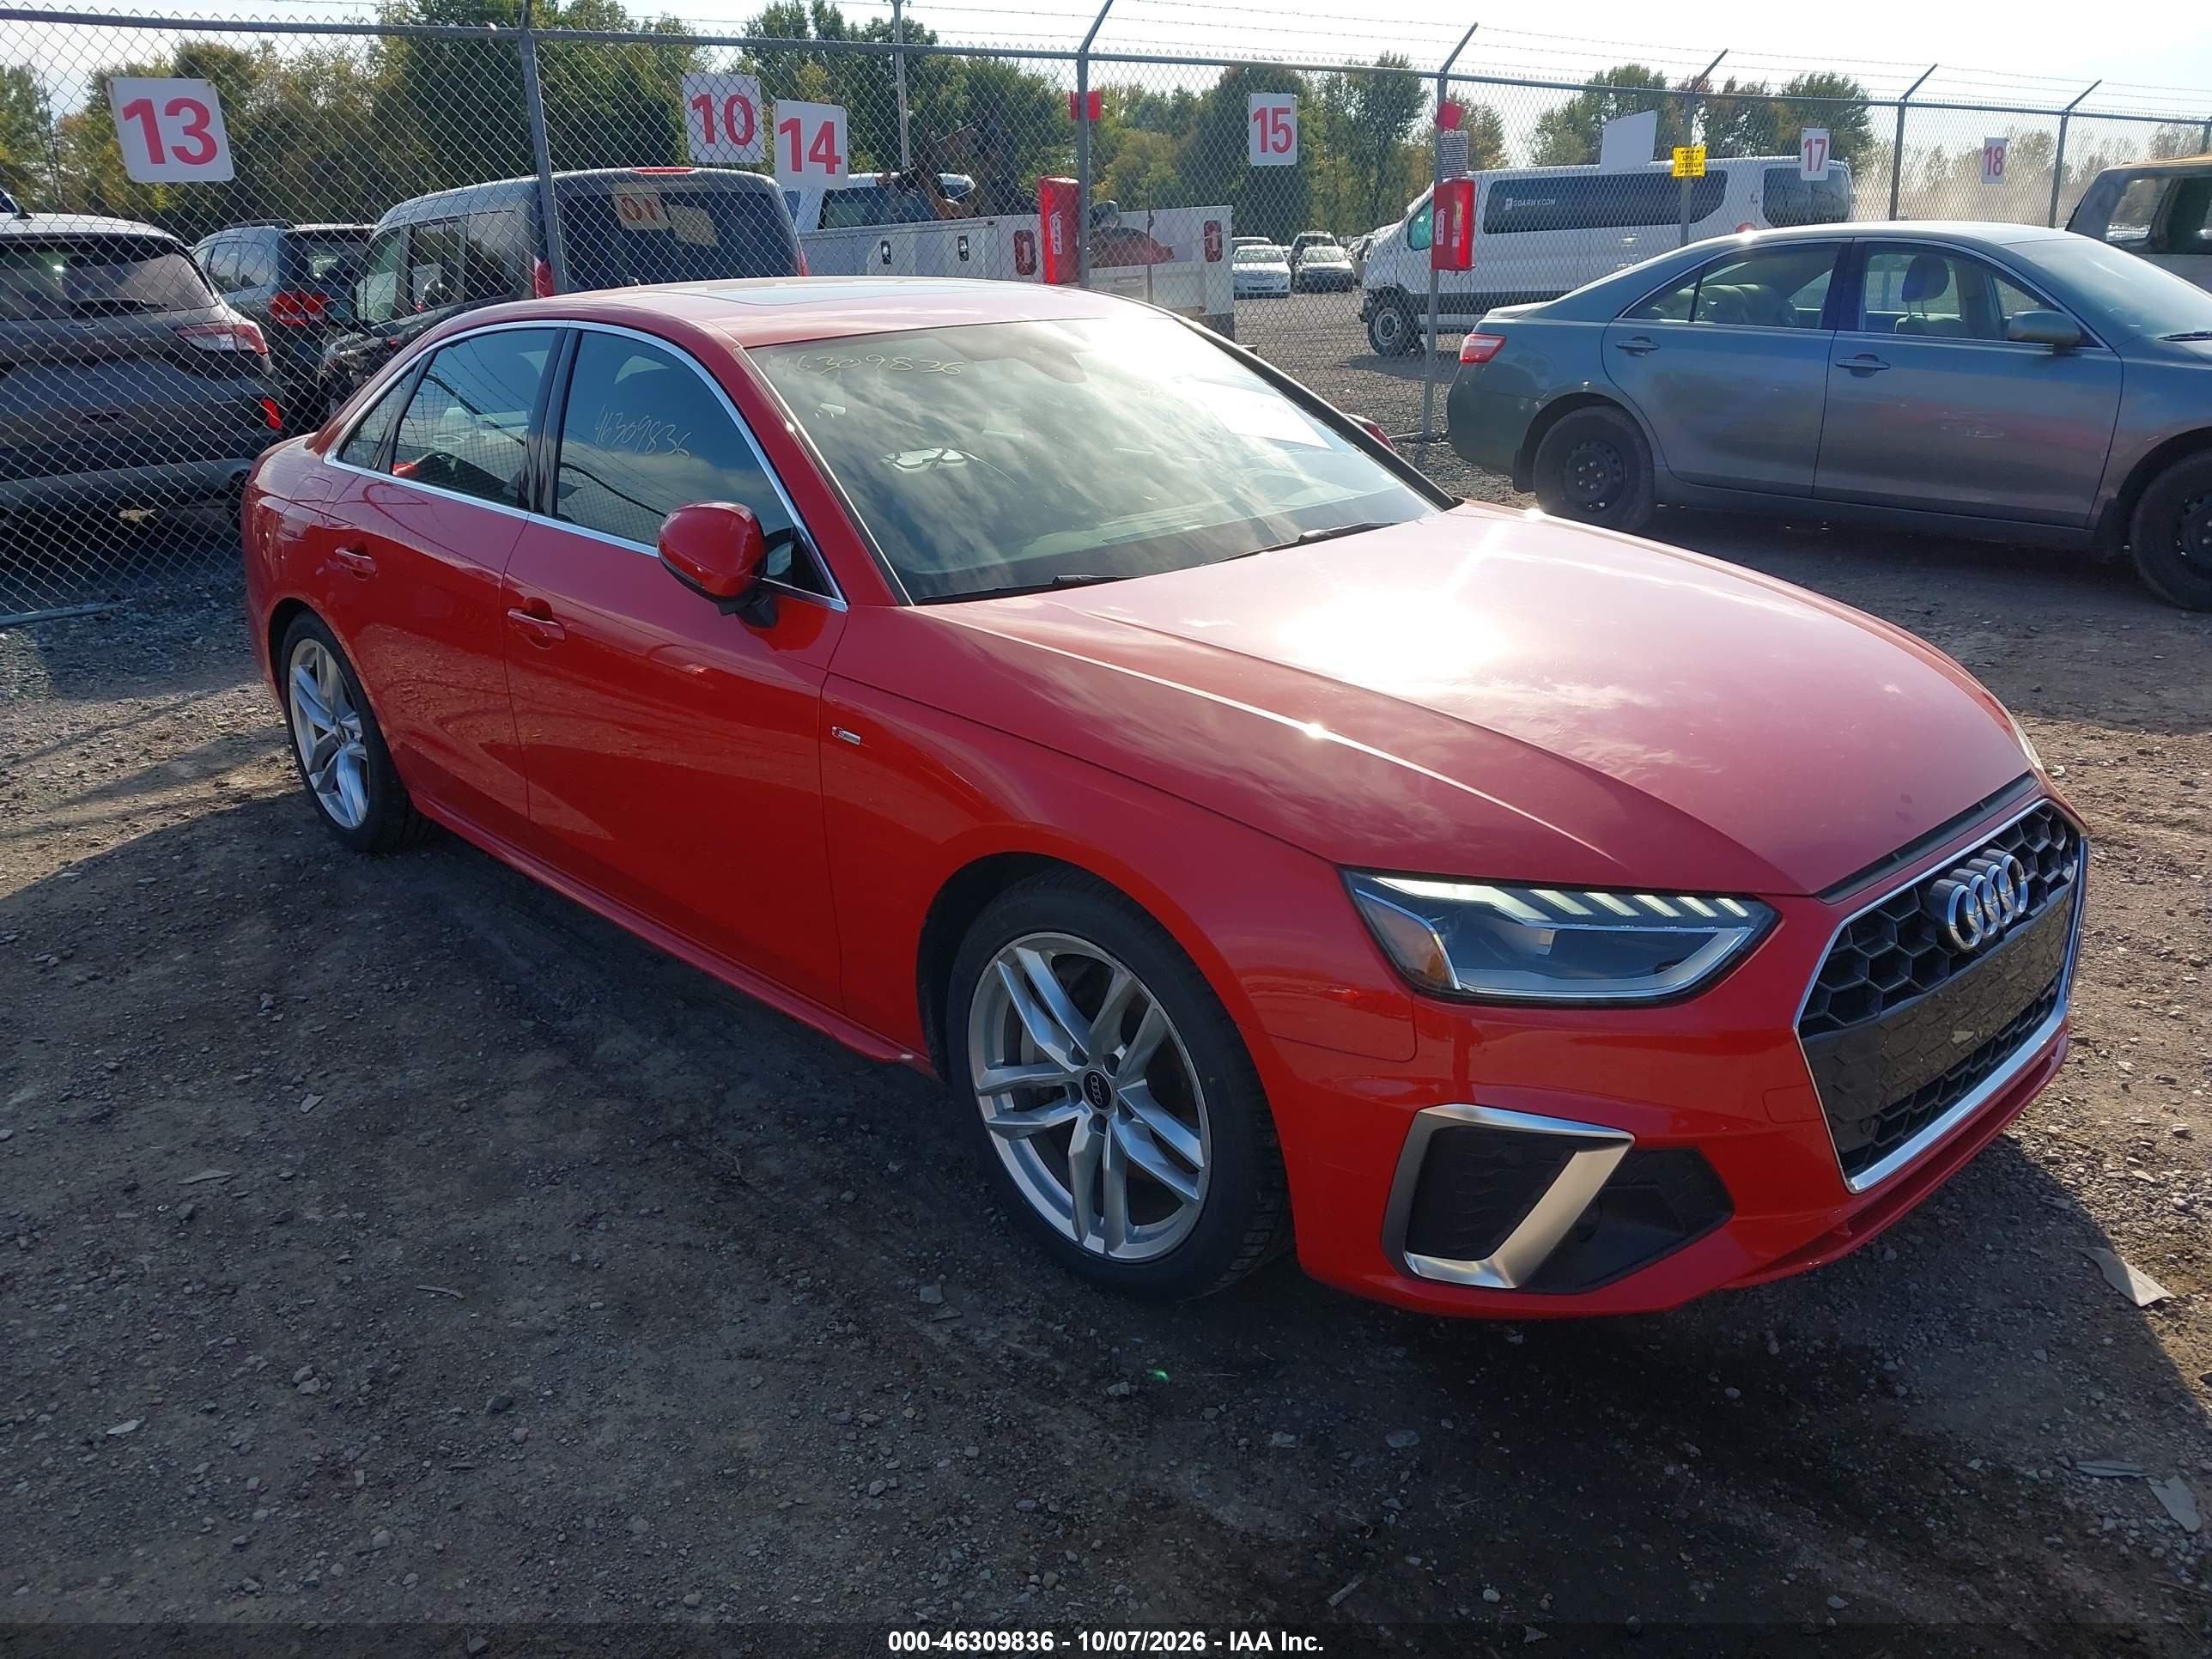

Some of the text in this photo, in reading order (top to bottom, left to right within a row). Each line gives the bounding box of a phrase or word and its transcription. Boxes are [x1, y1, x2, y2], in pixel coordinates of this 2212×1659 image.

[122, 97, 218, 166] 13
[691, 94, 755, 146] 10
[1252, 106, 1293, 154] 15
[779, 117, 842, 174] 14
[1803, 137, 1827, 172] 17
[1984, 145, 2005, 177] 18
